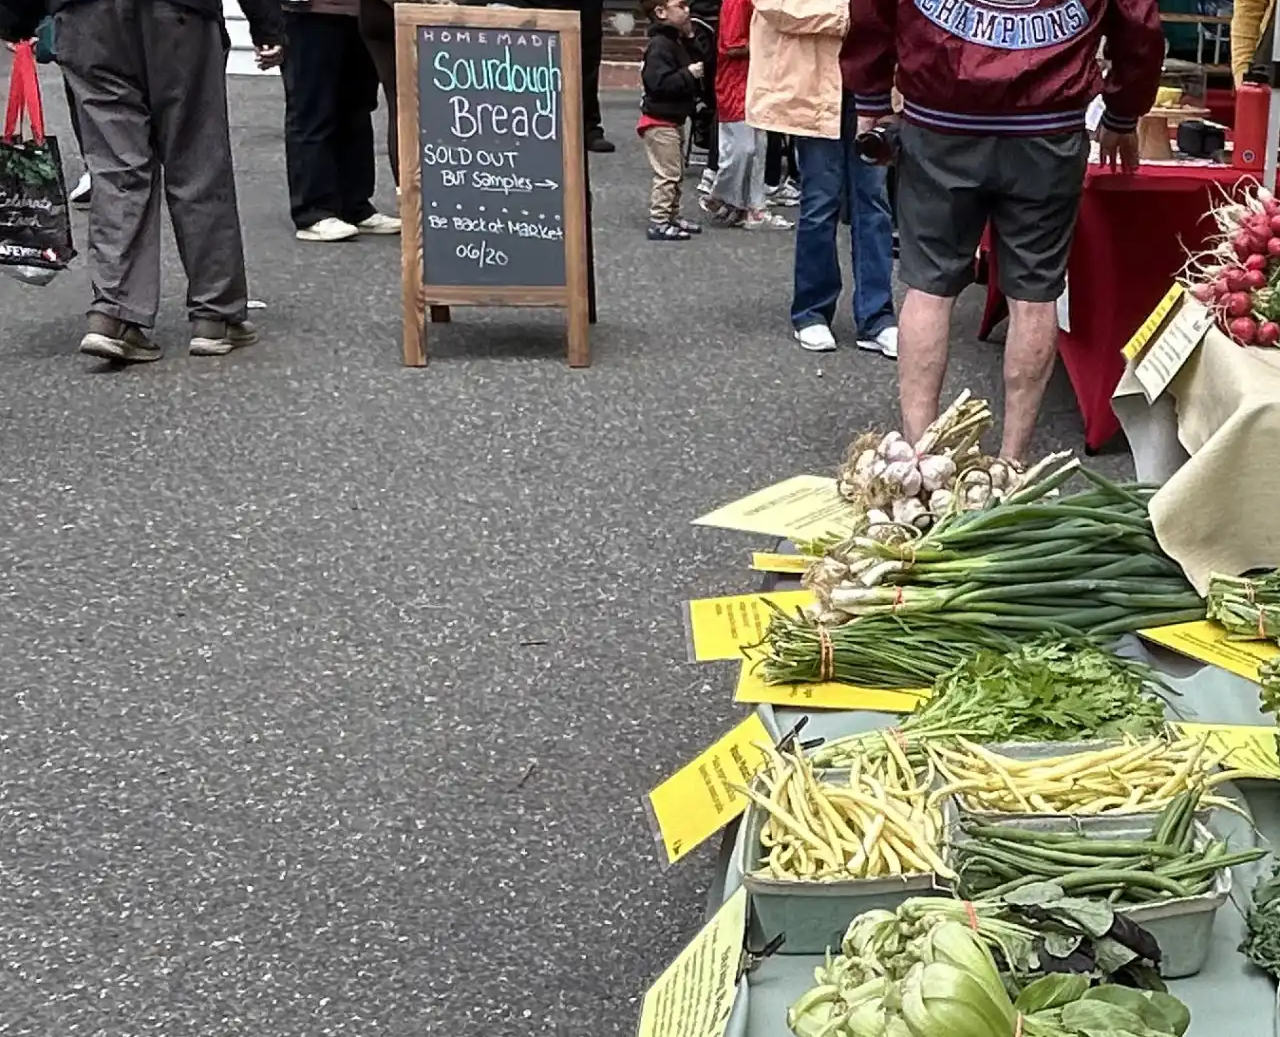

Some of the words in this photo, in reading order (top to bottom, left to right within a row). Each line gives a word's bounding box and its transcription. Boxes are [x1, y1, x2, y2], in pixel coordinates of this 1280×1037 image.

[424, 30, 557, 48] HOMEMADE
[433, 45, 562, 115] Sourdough
[449, 91, 556, 140] Bread
[424, 144, 472, 165] SOLD
[476, 150, 518, 168] OUT
[472, 171, 533, 195] Samples
[456, 240, 509, 268] 06/20
